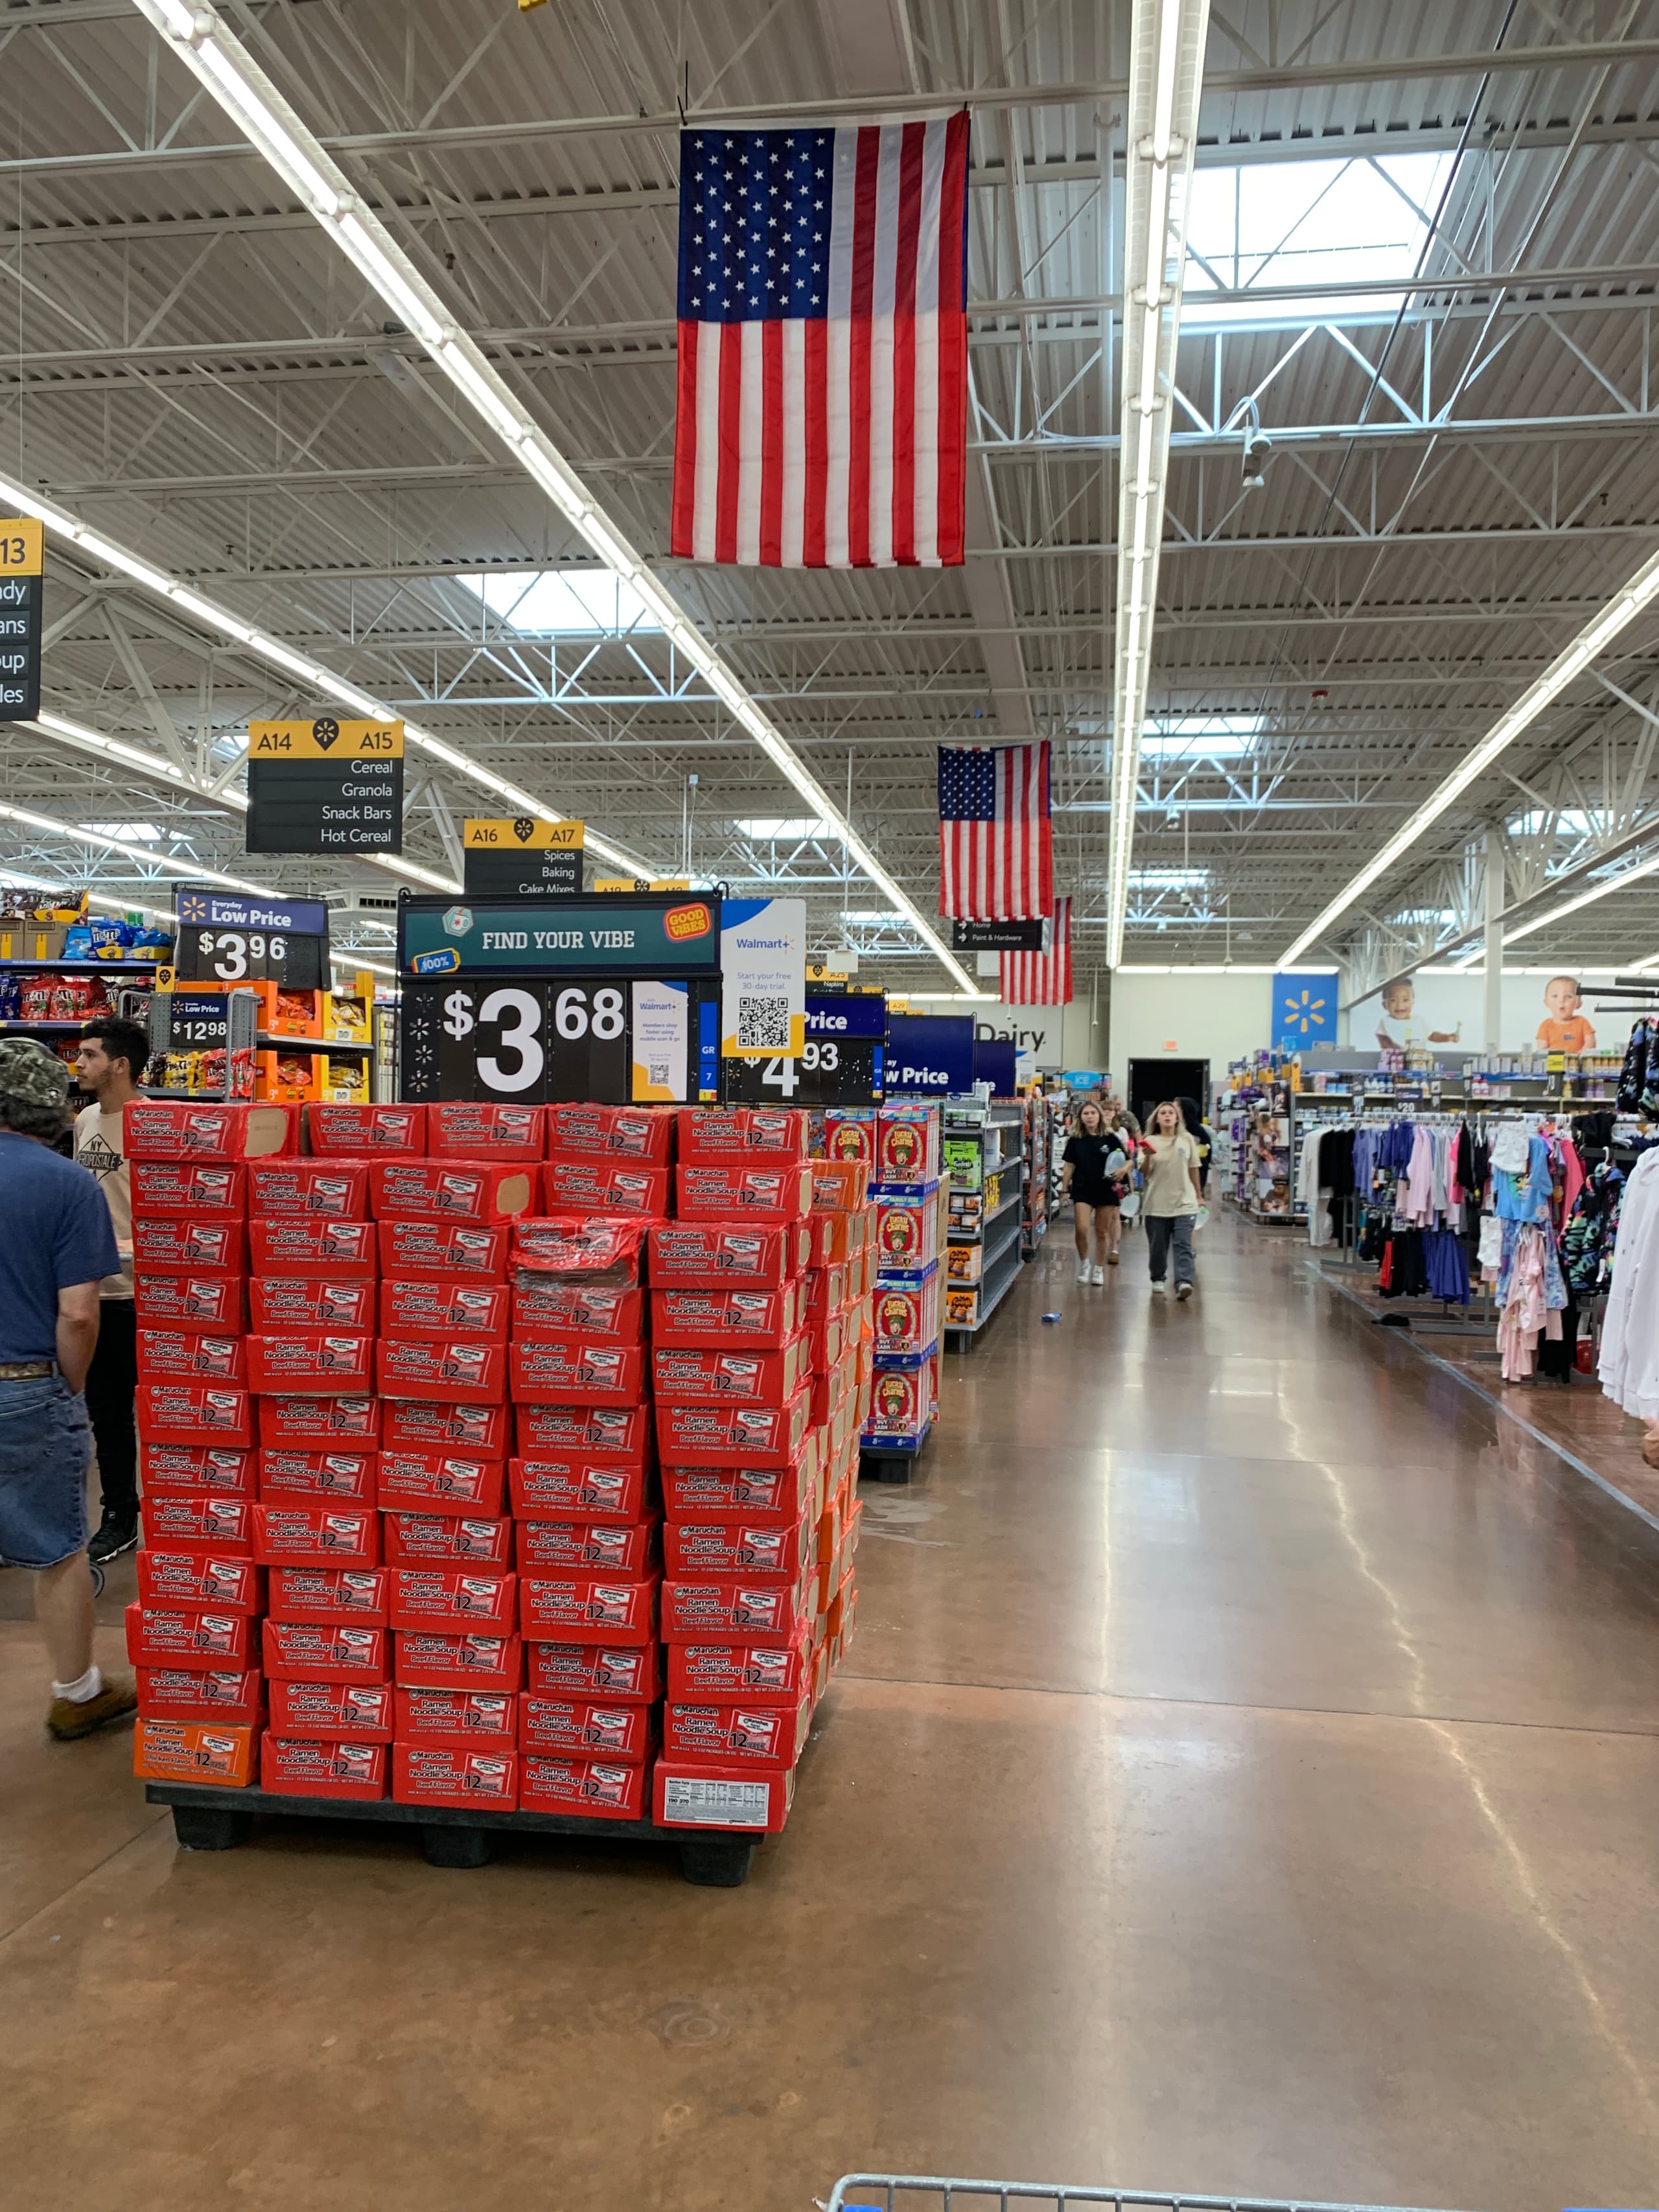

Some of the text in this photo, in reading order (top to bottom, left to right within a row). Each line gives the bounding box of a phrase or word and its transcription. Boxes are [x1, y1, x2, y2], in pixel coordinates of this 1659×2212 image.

[0, 537, 25, 565] 13
[0, 580, 26, 605] dy
[0, 620, 26, 634] ans
[0, 654, 25, 674] up
[0, 684, 23, 703] les
[257, 732, 393, 751] A14 A15
[351, 760, 393, 773] Cereal
[342, 783, 393, 796] Granola
[322, 806, 392, 819] Snack Bars
[321, 829, 391, 843] Hot Cereal
[472, 829, 575, 843] A16 A17
[544, 850, 575, 862] Spices
[542, 867, 575, 879] Baking
[519, 884, 575, 892] Cake Mixes
[212, 900, 242, 910] Everyday
[211, 907, 292, 927] Low Price
[669, 909, 704, 926] GOOD
[671, 919, 706, 937] VIBES
[482, 931, 634, 949] FIND YOUR VIBE
[737, 939, 789, 948] Walmart+
[421, 956, 450, 972] 100%
[742, 983, 768, 991] 30-day
[804, 1011, 848, 1029] Price
[977, 1023, 1045, 1053] Dairy
[702, 1046, 715, 1054] GR
[903, 1067, 949, 1084] Price
[183, 1132, 198, 1145] 12
[747, 1132, 763, 1145] 12
[841, 1130, 859, 1138] Lucky
[894, 1130, 912, 1139] Lucky
[91, 1140, 102, 1151] NY
[838, 1137, 861, 1146] Charms
[891, 1138, 914, 1147] Charms
[308, 1196, 323, 1209] 12
[537, 1476, 567, 1484] Ramen
[525, 1482, 579, 1495] Noodle Soup
[581, 1490, 597, 1503] 12
[682, 1706, 717, 1715] Maruchan
[686, 1718, 715, 1727] Ramen
[152, 1726, 184, 1735] Maruchan
[673, 1725, 728, 1736] Noodle Soup
[156, 1738, 182, 1746] Ramen
[730, 1733, 747, 1747] 12
[172, 1747, 193, 1756] Soup
[195, 1753, 210, 1765] 12
[442, 1771, 462, 1780] Soup
[465, 1775, 481, 1789] 12
